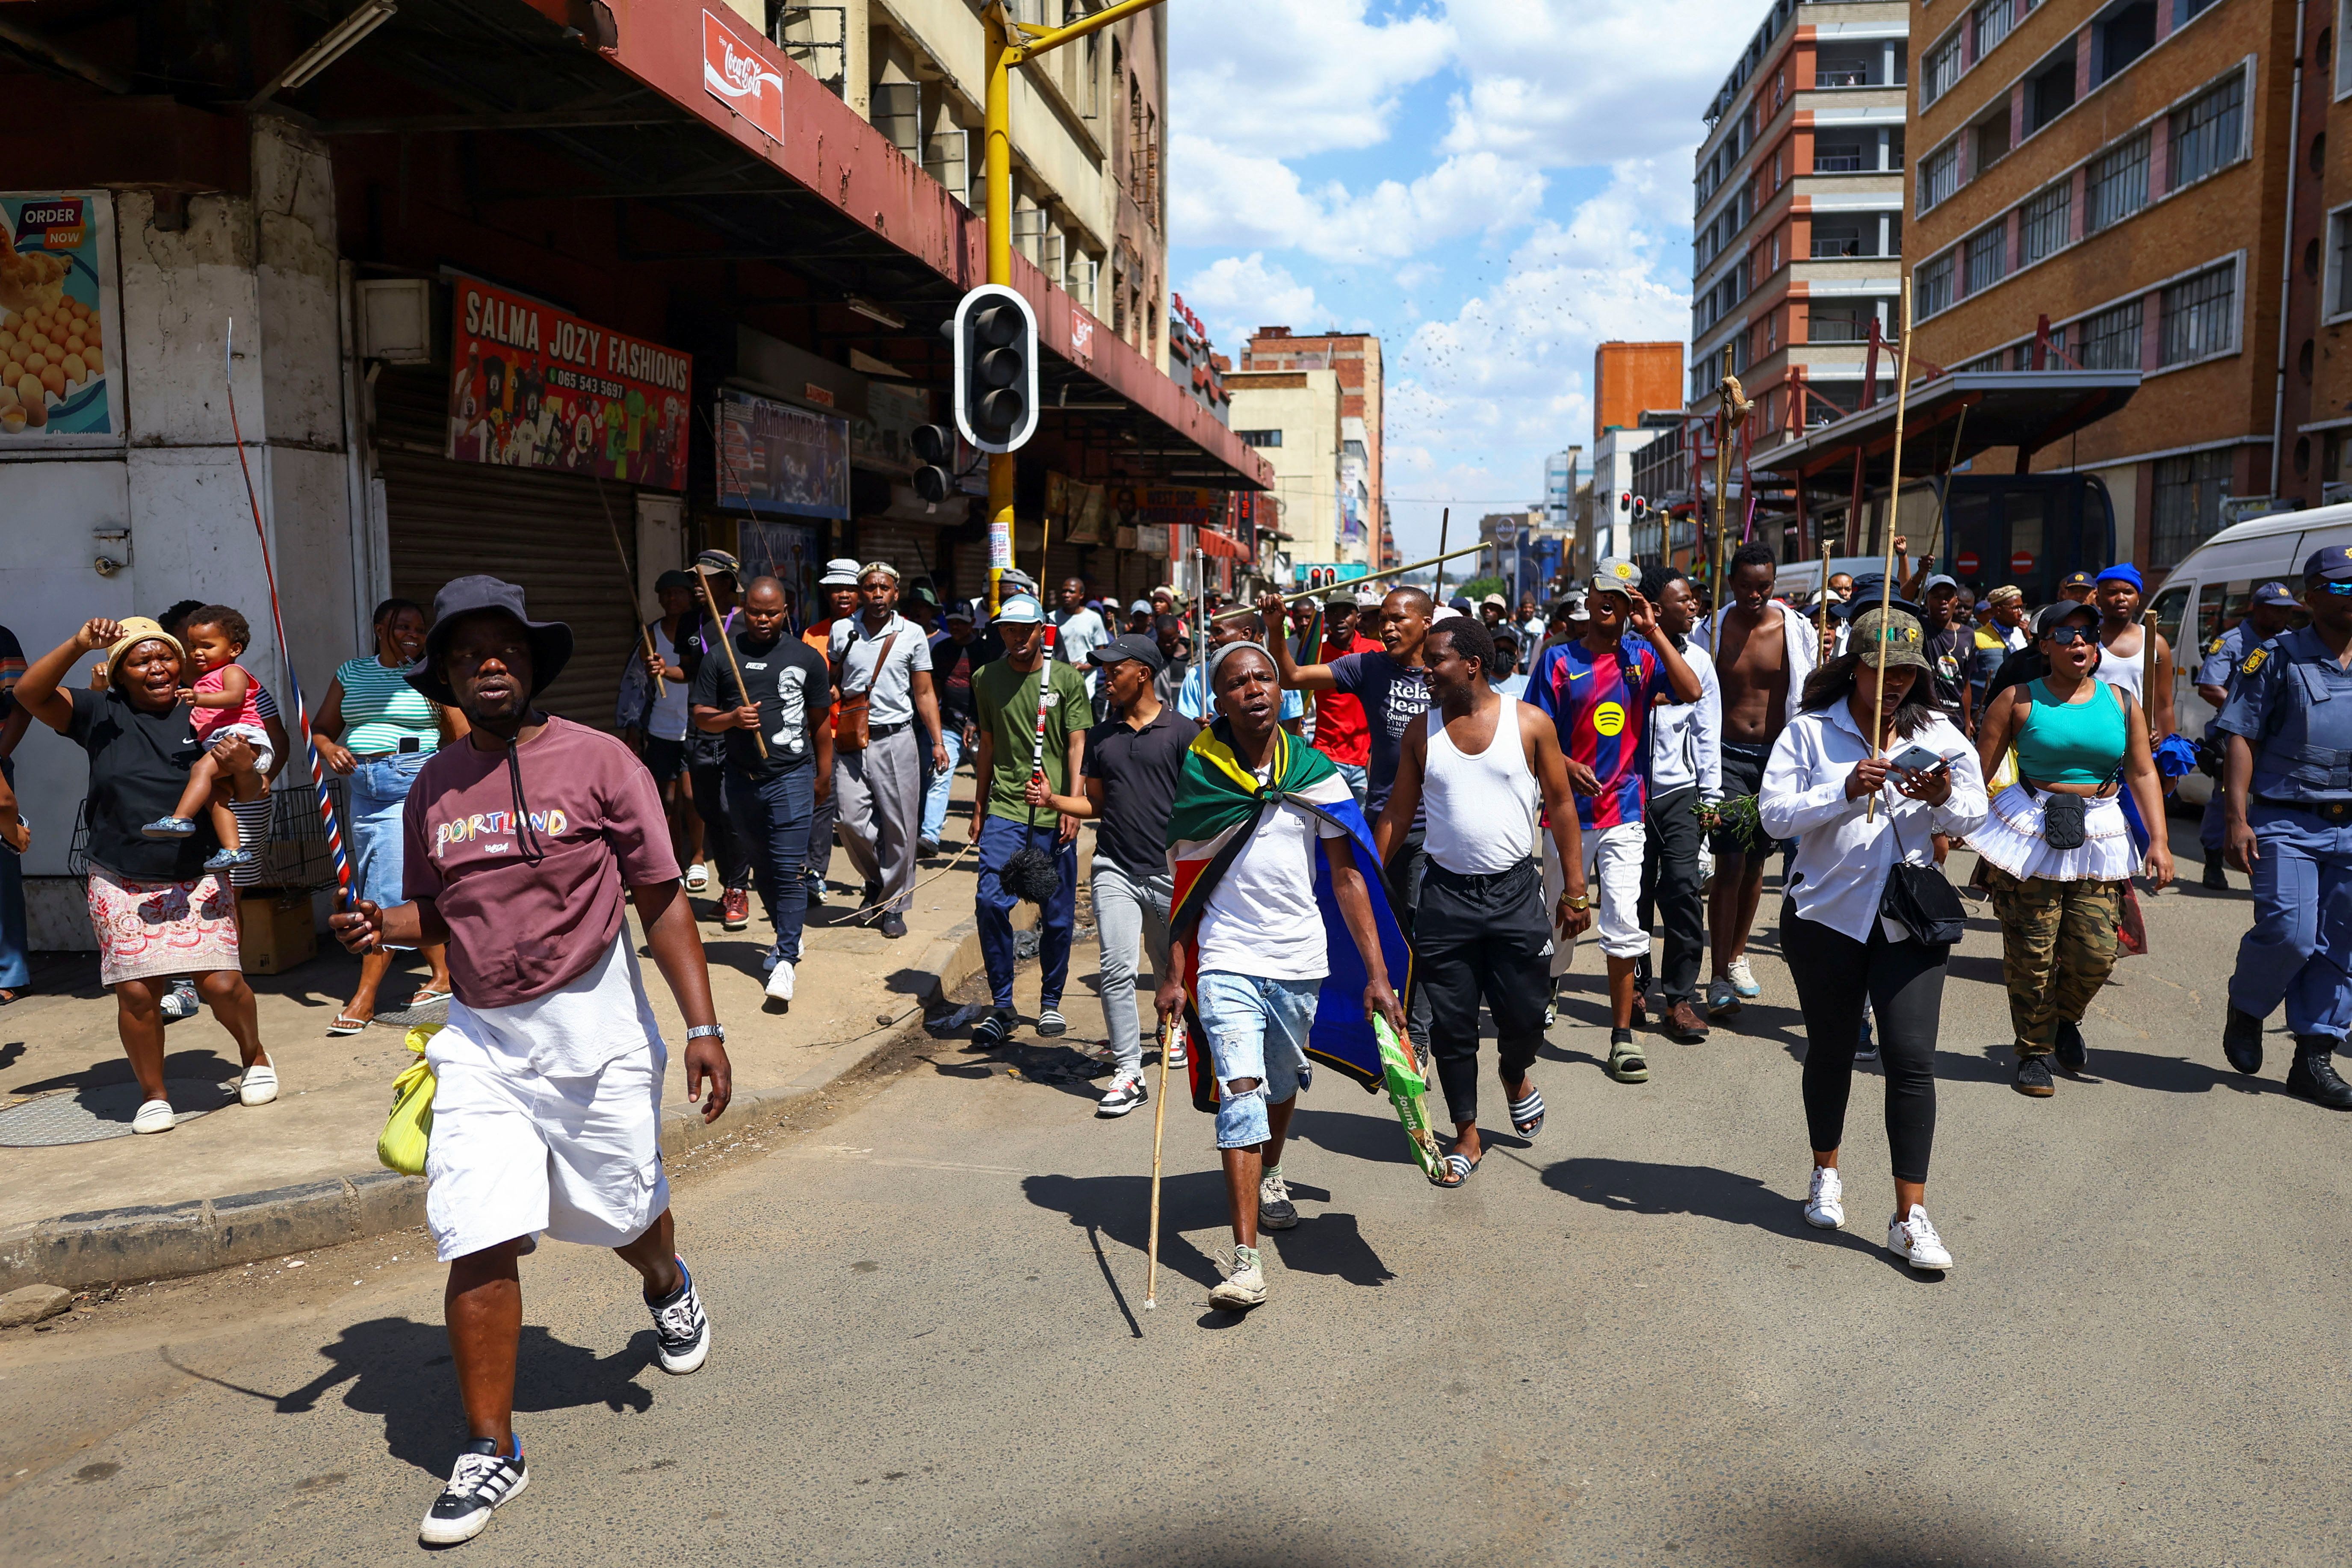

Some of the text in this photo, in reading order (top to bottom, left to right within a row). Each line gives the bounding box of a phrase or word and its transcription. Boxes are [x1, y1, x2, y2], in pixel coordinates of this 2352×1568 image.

[25, 209, 74, 223] ORDER
[50, 233, 80, 243] NOW
[465, 290, 687, 393] SALMA JOZY FASHIONS
[558, 369, 624, 399] 065 543 5697
[1389, 679, 1431, 700] Rela
[1387, 712, 1412, 722] Qualit
[436, 809, 567, 859] PORTLAND
